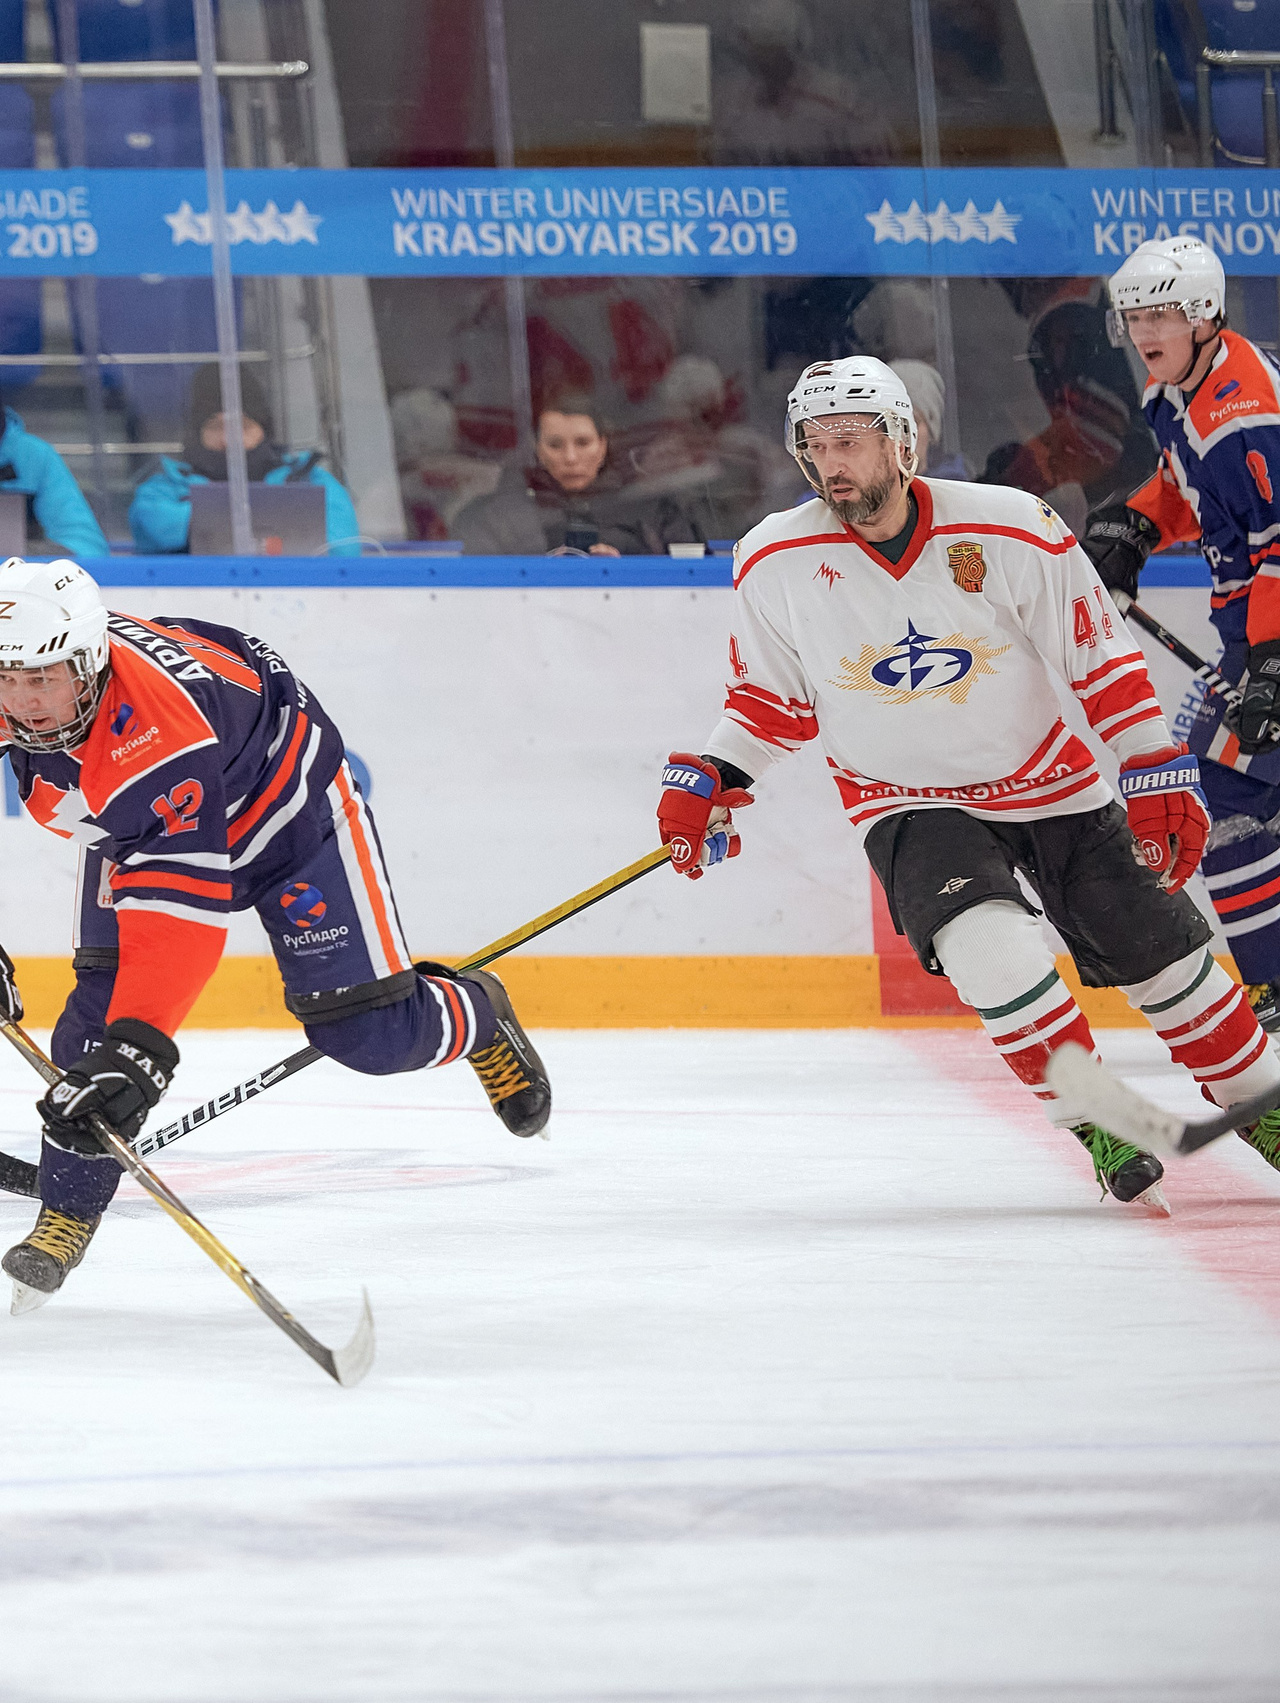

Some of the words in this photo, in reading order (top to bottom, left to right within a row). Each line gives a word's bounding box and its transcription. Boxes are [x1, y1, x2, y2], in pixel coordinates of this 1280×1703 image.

[390, 187, 538, 219] WINTER
[544, 187, 792, 218] UNIVERSIADE
[1091, 187, 1236, 218] WINTER
[6, 221, 99, 259] 2019
[393, 221, 700, 258] KRASNOYARSK
[707, 221, 798, 257] 2019
[803, 385, 837, 396] CCM
[895, 400, 910, 409] CCM
[1209, 399, 1260, 422] РусГидро
[110, 726, 160, 762] РусГидро
[150, 778, 204, 836] 12
[282, 925, 349, 949] РусГидро
[115, 1042, 167, 1091] MAD
